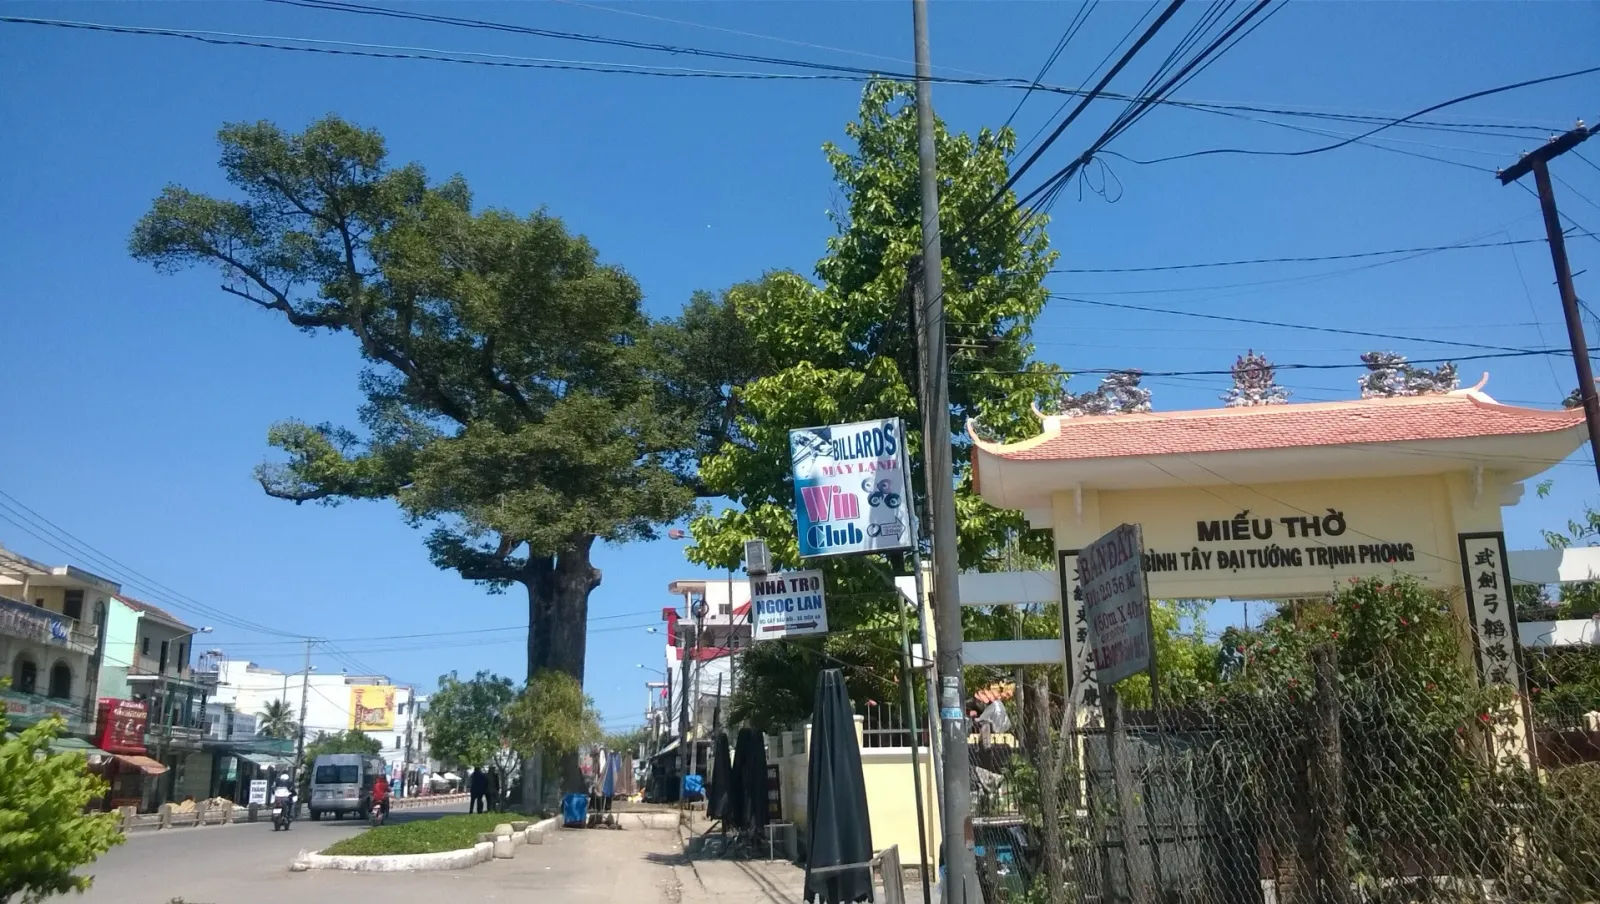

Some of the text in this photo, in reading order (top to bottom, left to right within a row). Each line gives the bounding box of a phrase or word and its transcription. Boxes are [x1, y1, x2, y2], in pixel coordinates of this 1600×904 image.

[832, 423, 897, 461] BILLARDS
[822, 463, 854, 476] MÁY
[801, 485, 860, 523] Win
[807, 522, 863, 549] Club
[1197, 508, 1347, 542] MIẾU THỜ
[1142, 542, 1415, 574] BÌNH TÂY ĐẠI TƯỚNG TRỊNH PHONG
[789, 576, 820, 594] TRỌ
[756, 594, 822, 615] NGỌC LAN
